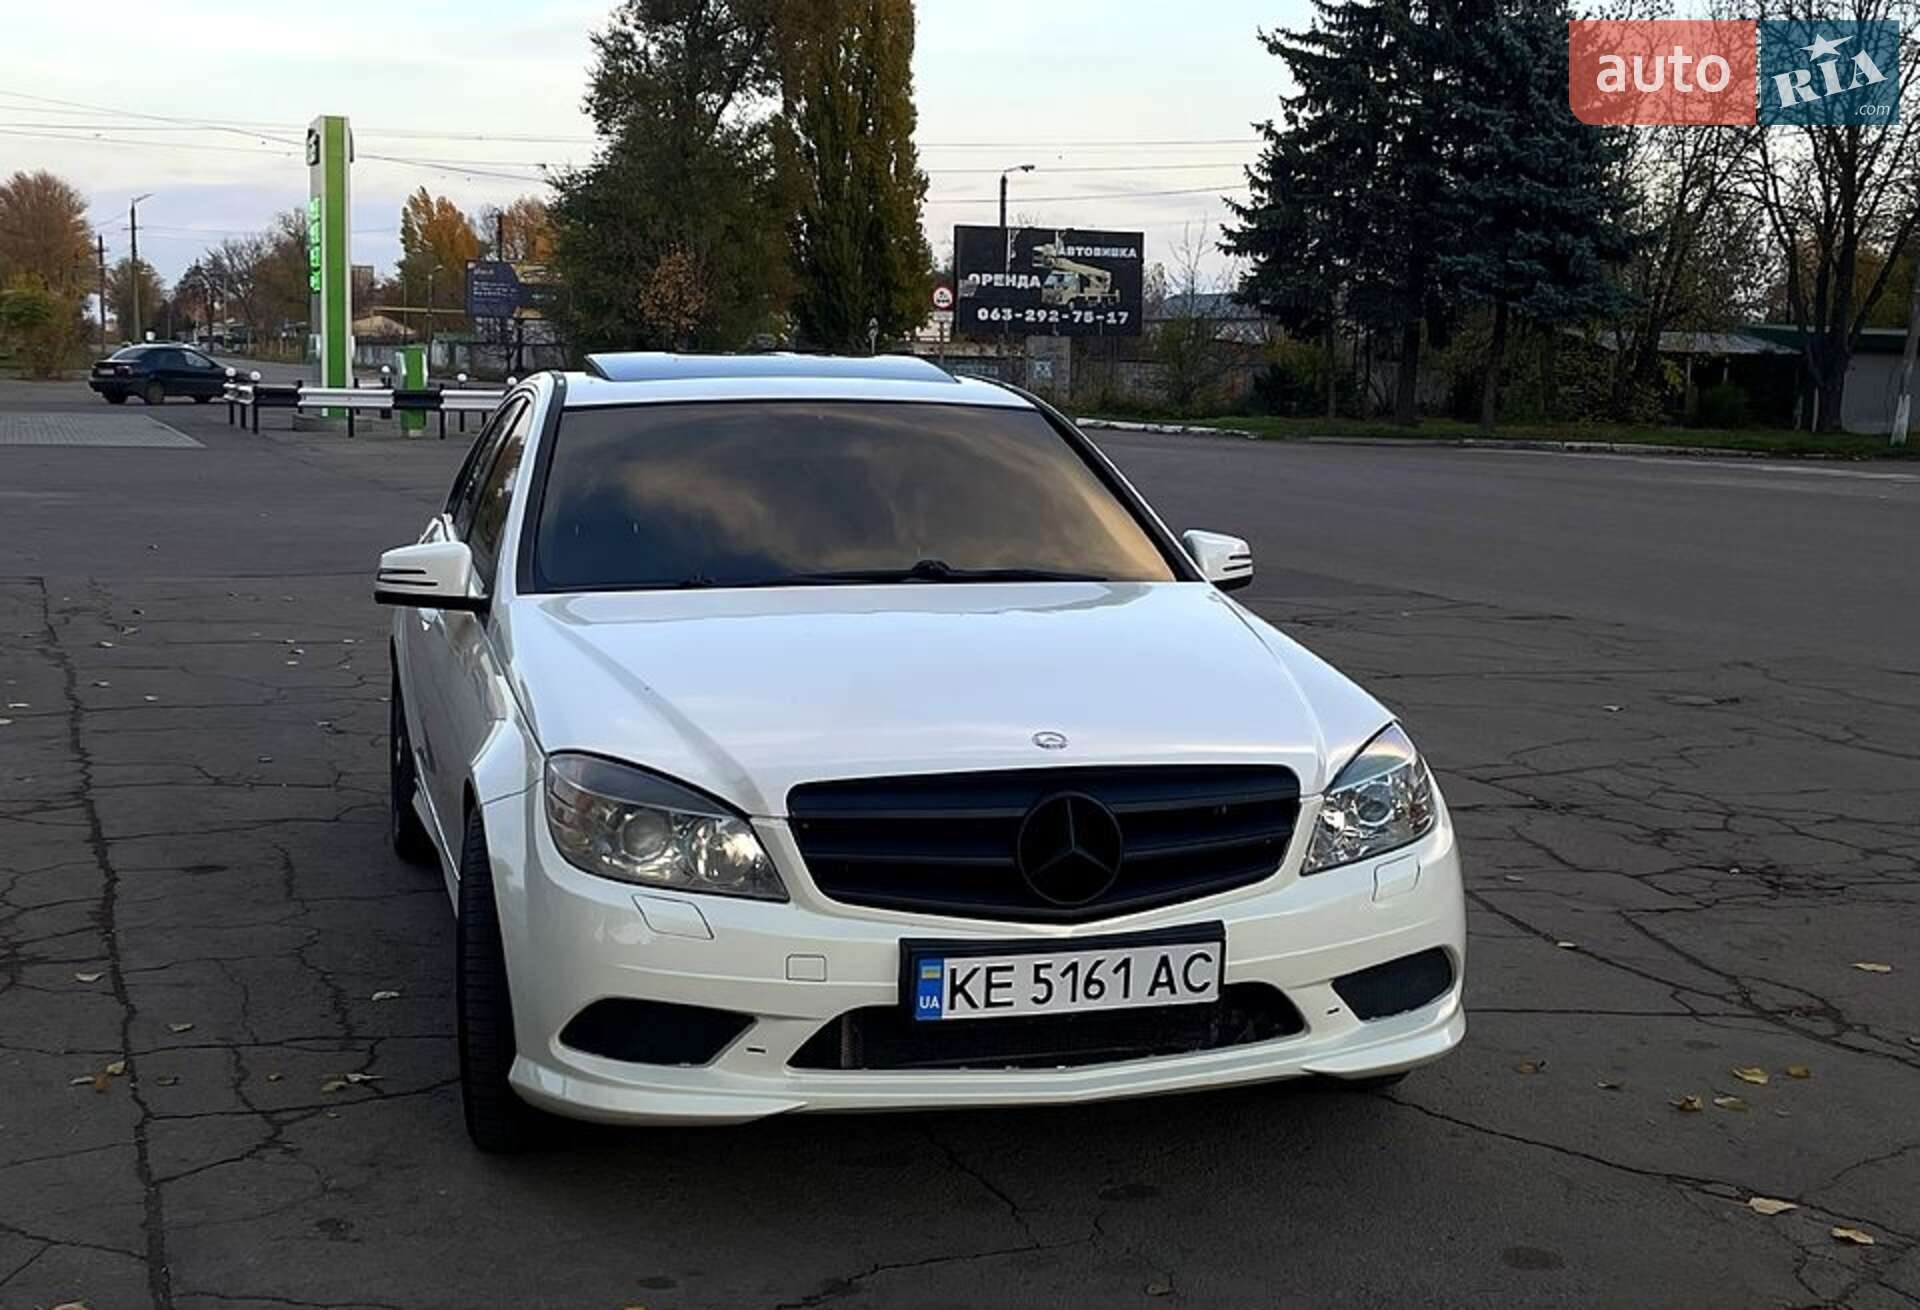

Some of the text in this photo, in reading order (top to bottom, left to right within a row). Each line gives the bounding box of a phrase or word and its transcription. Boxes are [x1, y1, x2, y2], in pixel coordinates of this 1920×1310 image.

[968, 273, 1041, 289] ОРЕНДА
[977, 308, 1129, 324] 063-292-75-17
[948, 952, 1213, 1010] KE 5161 AC
[919, 996, 940, 1009] UA
